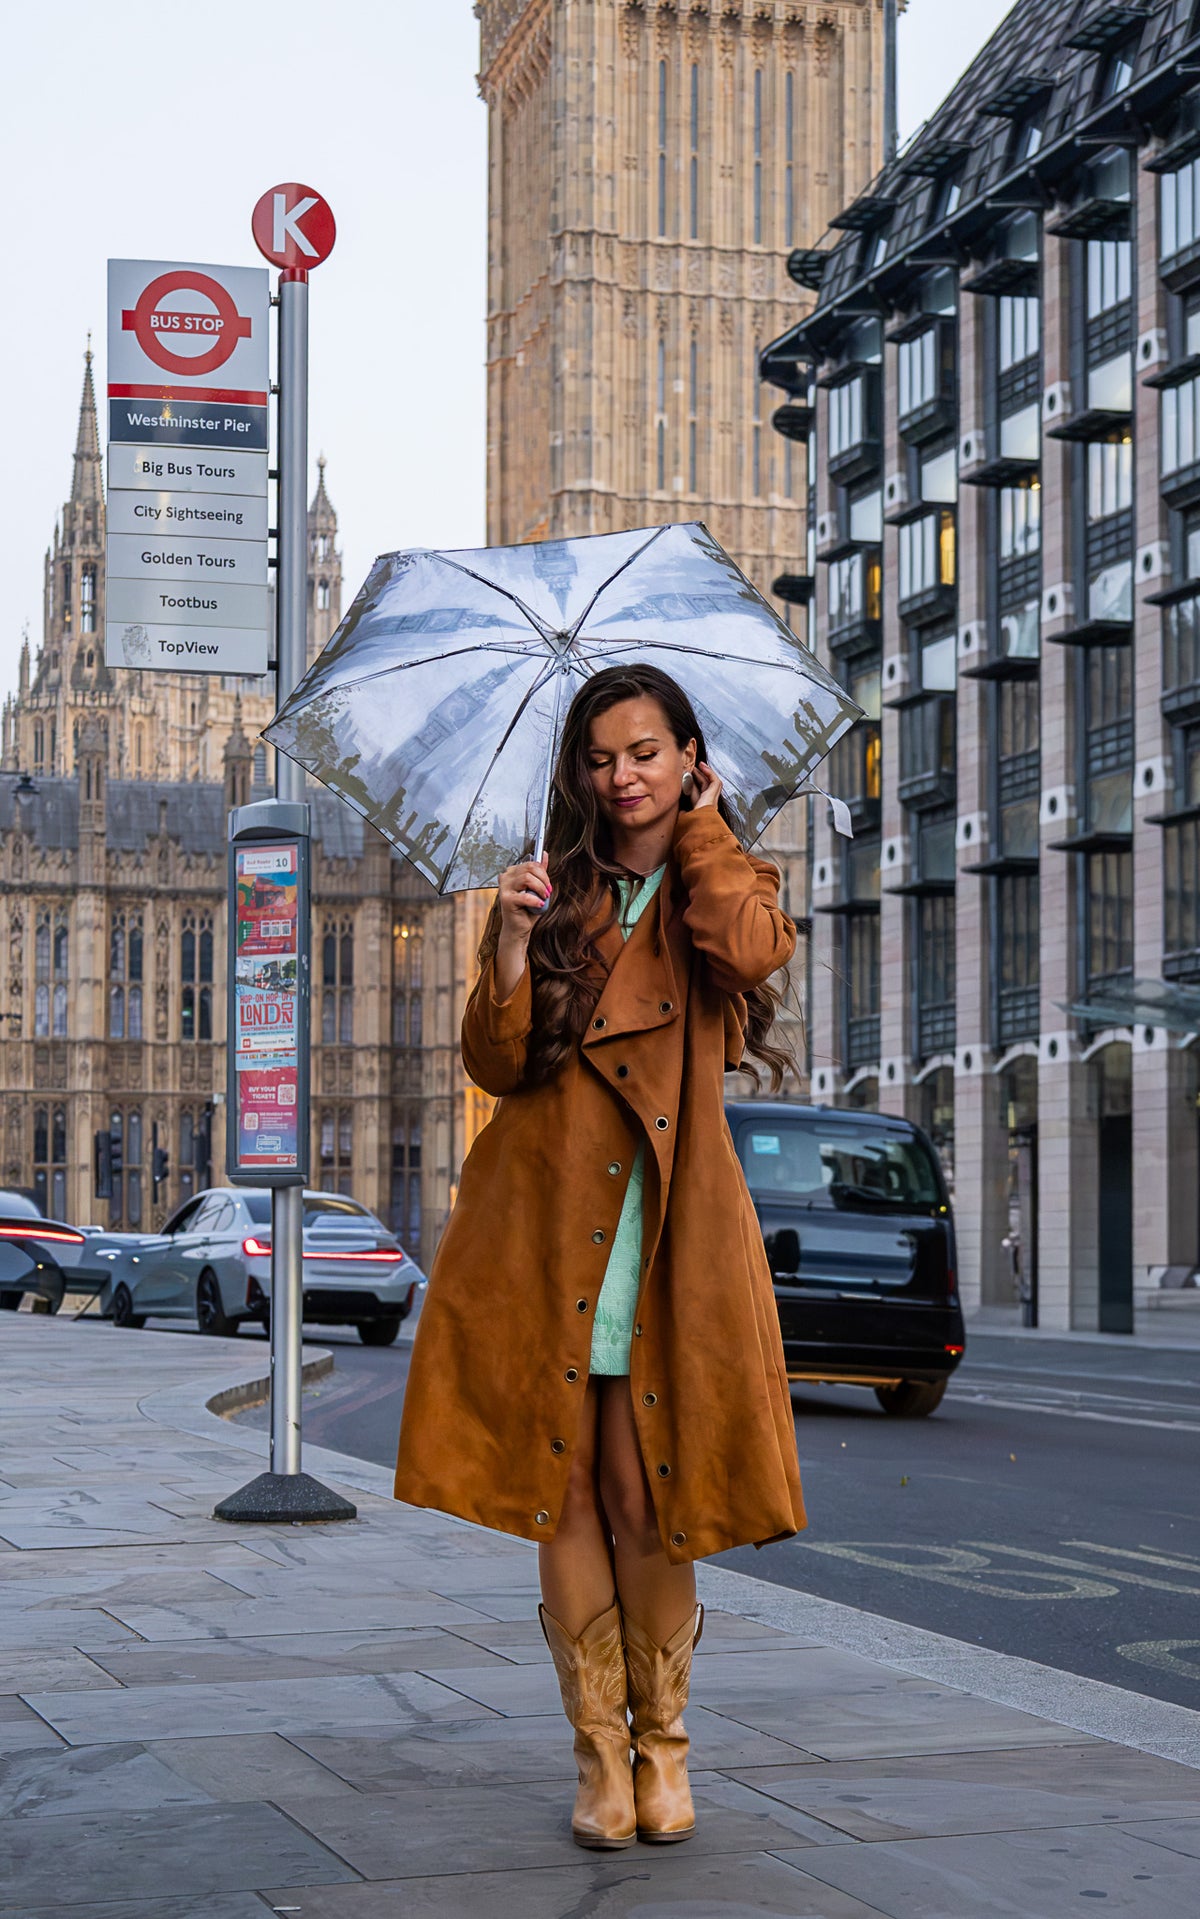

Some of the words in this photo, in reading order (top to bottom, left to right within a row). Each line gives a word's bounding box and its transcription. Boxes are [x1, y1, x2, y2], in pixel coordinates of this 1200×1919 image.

[273, 193, 320, 258] K
[150, 315, 180, 329] BUS
[184, 317, 224, 332] STOP
[127, 413, 220, 430] Westminster
[224, 418, 251, 433] Pier
[142, 461, 163, 476] Big
[167, 462, 192, 476] Bus
[196, 464, 235, 478] Tours
[134, 505, 162, 520] City
[166, 506, 243, 525] Sightseeing
[141, 551, 192, 566] Golden
[197, 554, 236, 569] Tours
[159, 595, 218, 610] Tootbus
[158, 640, 219, 655] TopView
[276, 858, 288, 868] 10
[240, 1002, 294, 1026] LONDON
